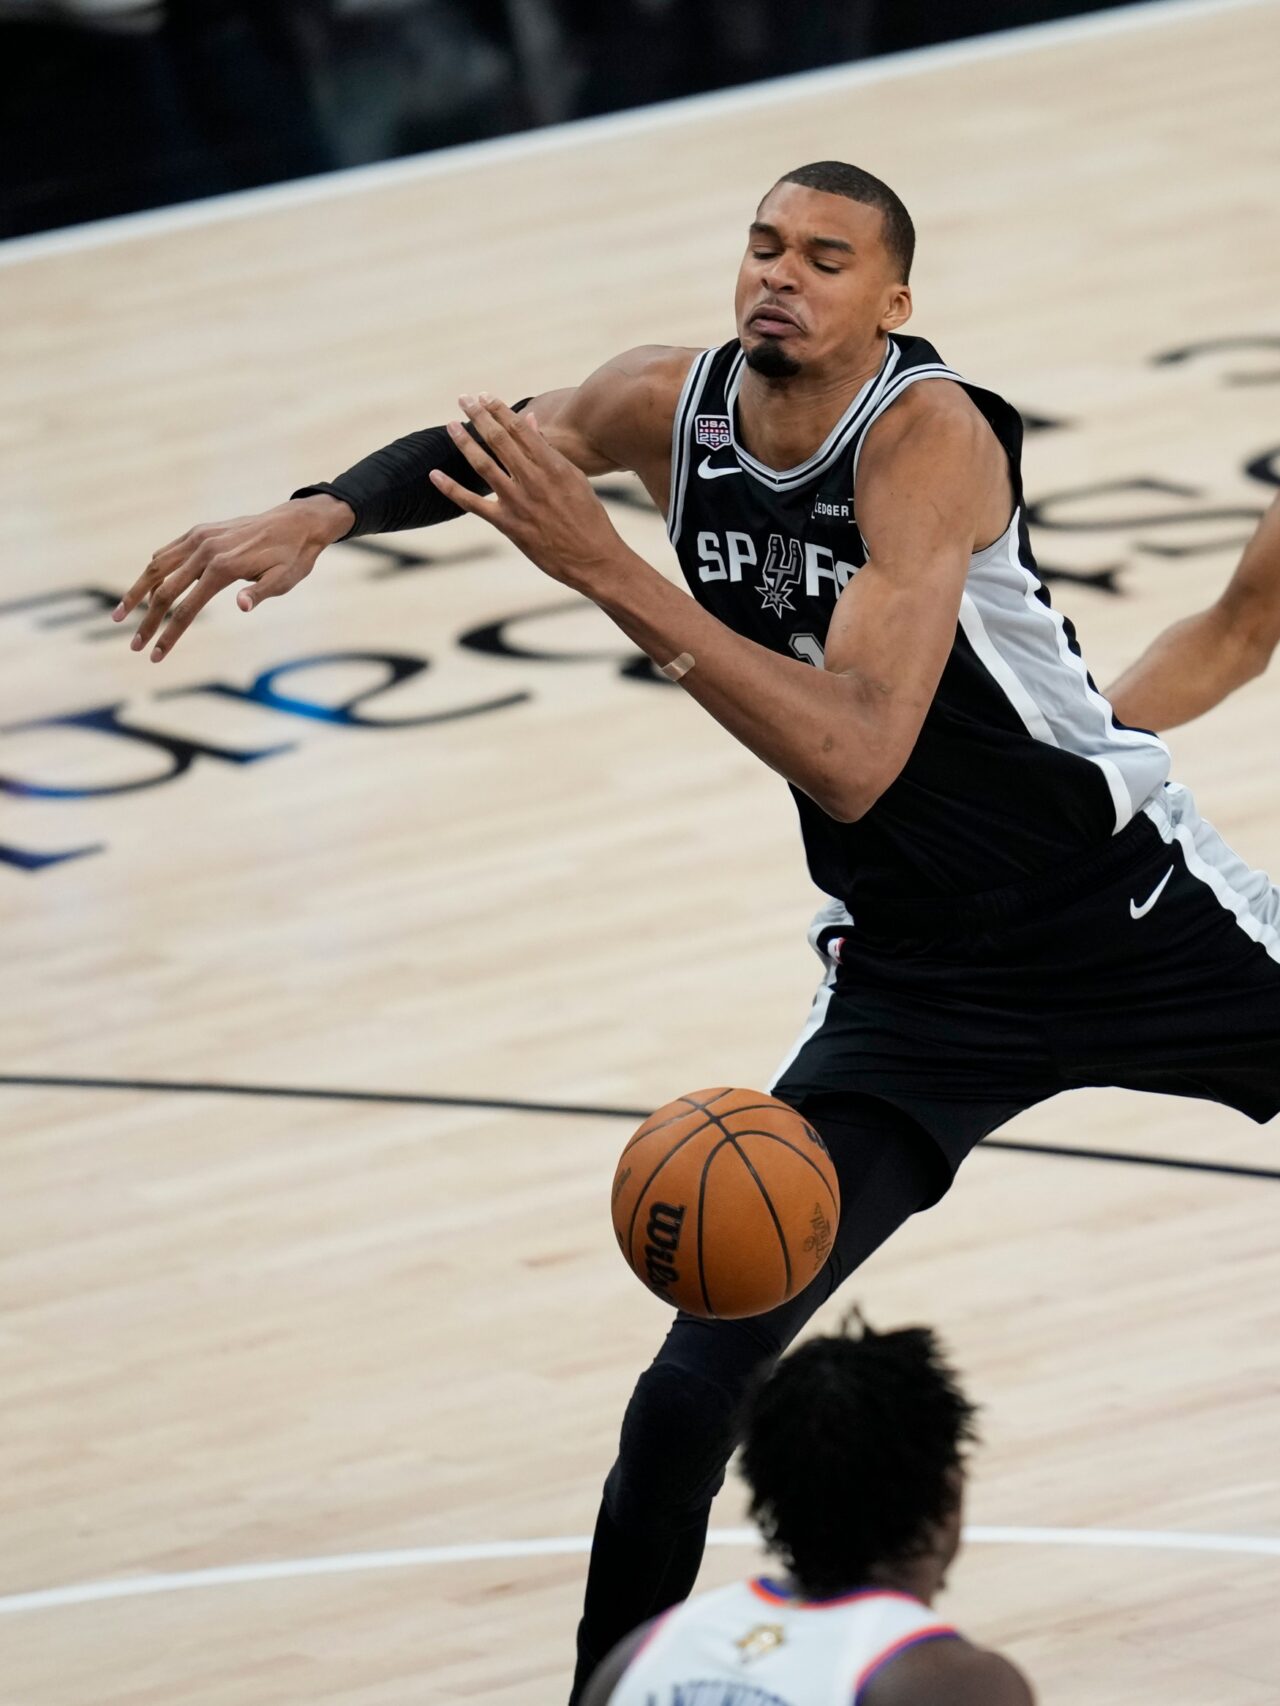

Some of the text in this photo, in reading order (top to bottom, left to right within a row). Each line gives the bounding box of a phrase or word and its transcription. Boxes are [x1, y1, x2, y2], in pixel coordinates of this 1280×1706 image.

[700, 420, 728, 428] USA
[699, 433, 730, 443] 250
[814, 501, 849, 517] LEDGER
